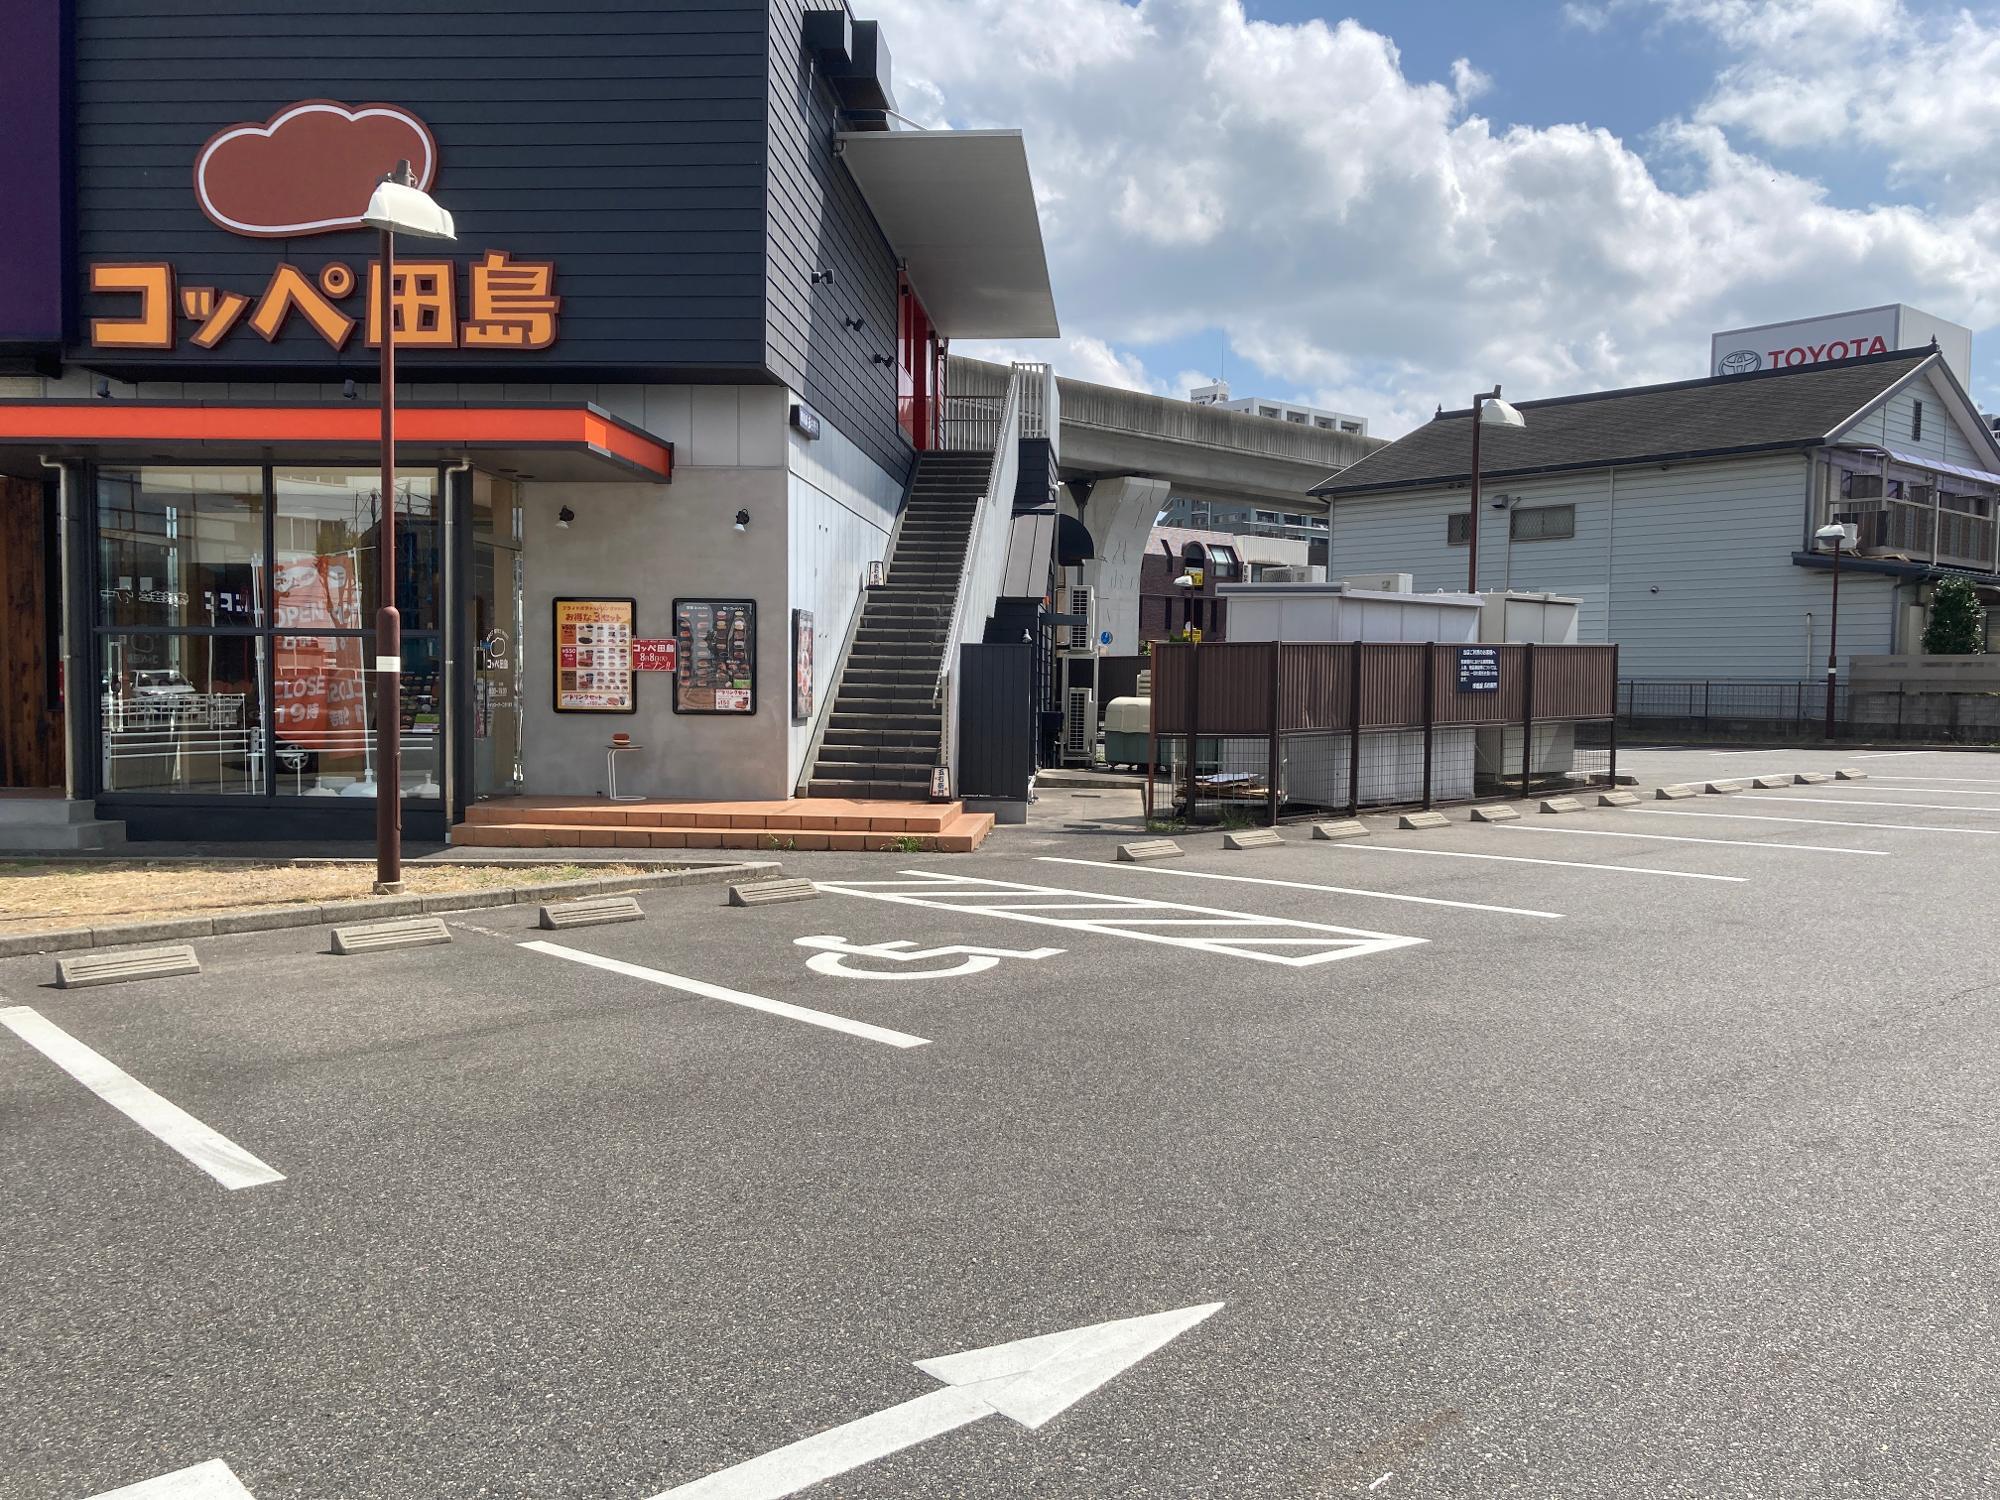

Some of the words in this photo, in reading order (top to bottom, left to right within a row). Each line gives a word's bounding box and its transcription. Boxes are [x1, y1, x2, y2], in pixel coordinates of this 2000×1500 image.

[90, 249, 561, 351] コッペ田島
[1768, 335, 1888, 368] TOYOTA
[633, 644, 674, 652] コッペ田島
[275, 675, 326, 699] CLOSE
